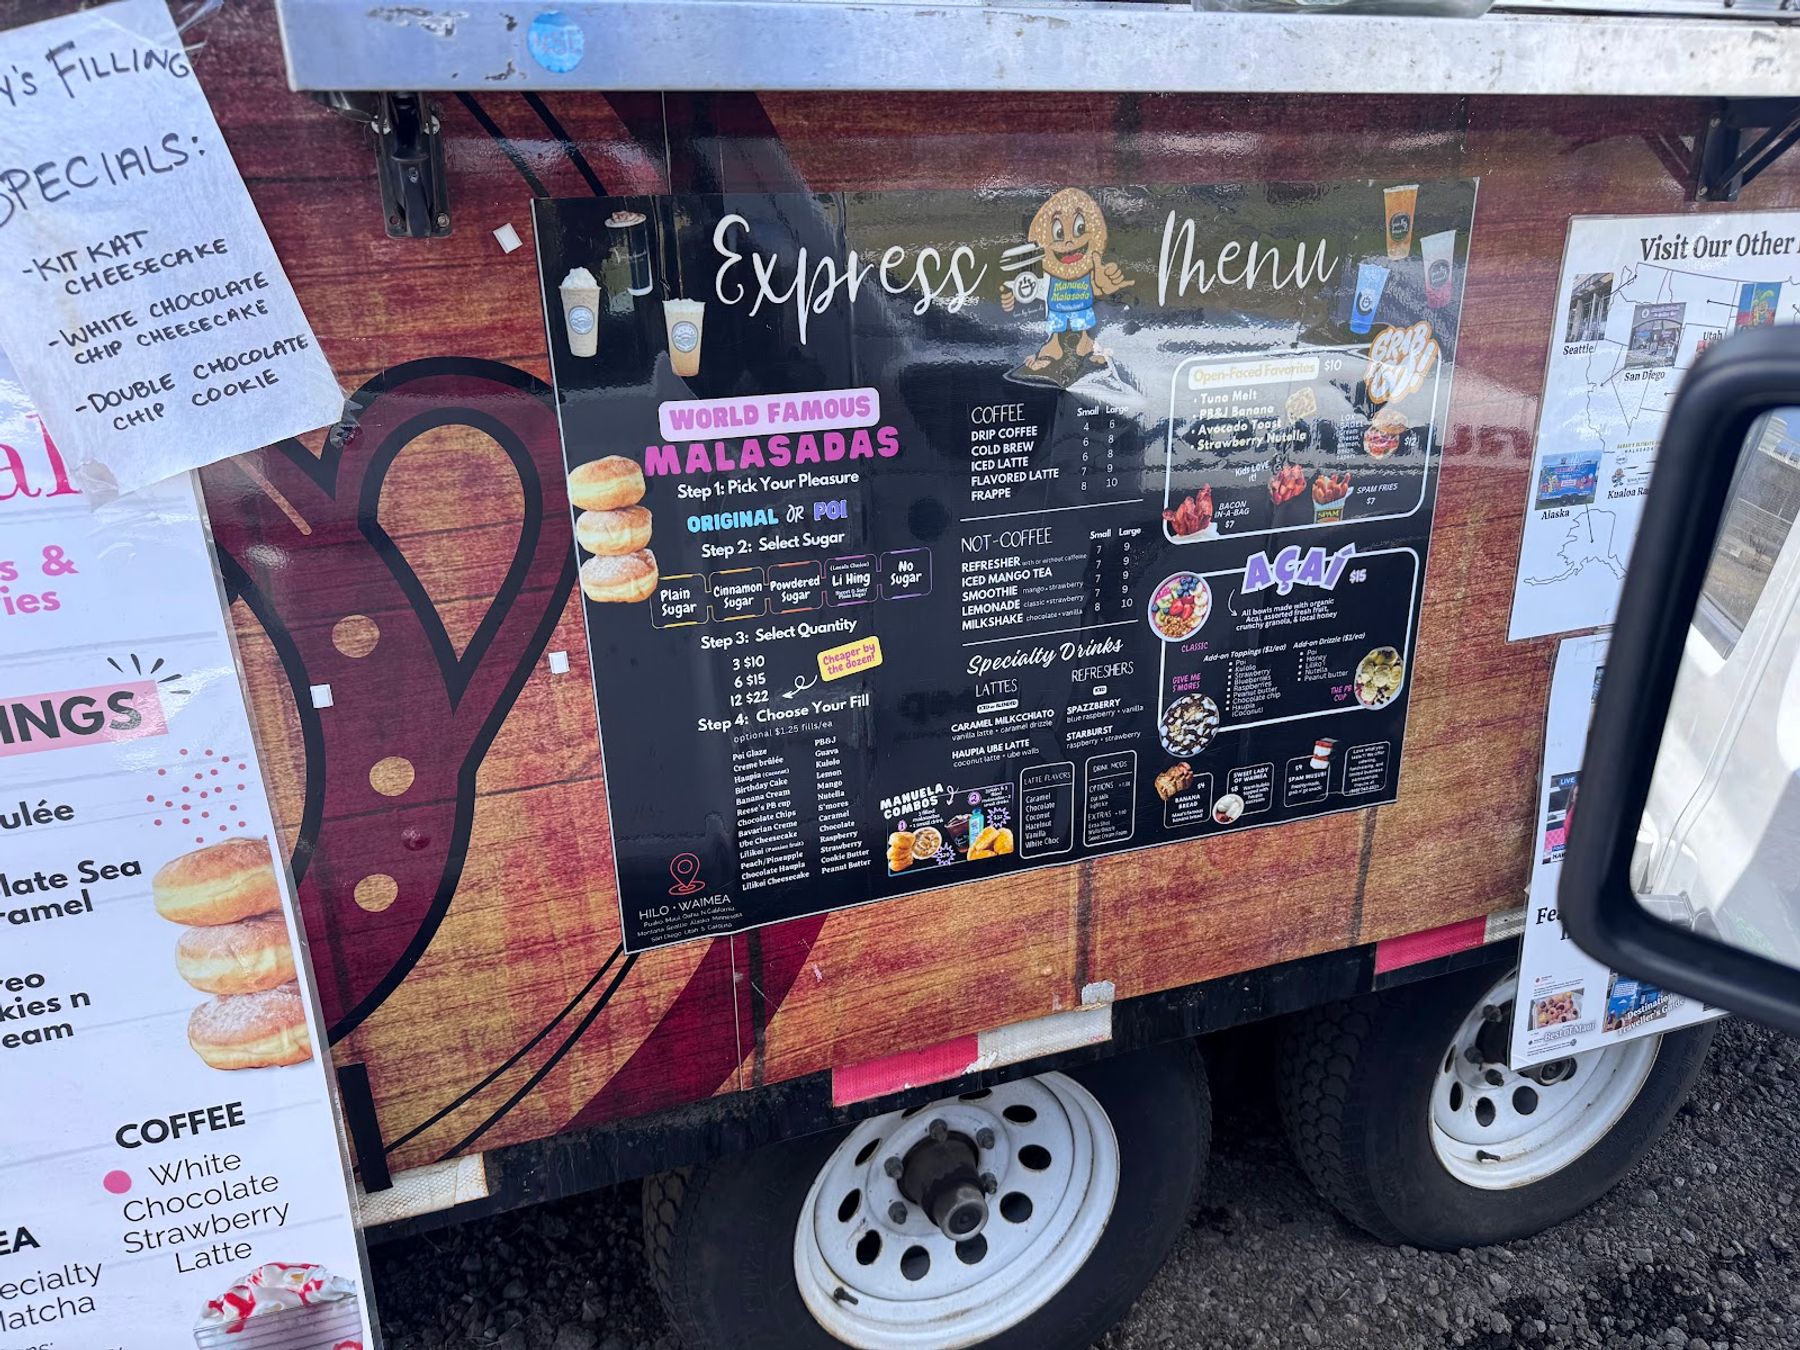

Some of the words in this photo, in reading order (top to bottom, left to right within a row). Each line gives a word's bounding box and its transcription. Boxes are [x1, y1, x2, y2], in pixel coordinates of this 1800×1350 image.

[46, 41, 191, 98] FILLING
[1640, 234, 1689, 261] Visit
[1693, 235, 1732, 259] Our
[1736, 231, 1795, 257] Other
[22, 250, 80, 282] -KIT
[86, 230, 150, 264] KAT
[64, 238, 229, 296] CHEESECAKE
[713, 213, 987, 345] Express
[1158, 209, 1339, 307] Menu
[47, 310, 139, 349] -WHITE
[149, 272, 270, 319] CHOCOLATE
[73, 339, 123, 367] CHIP
[136, 300, 270, 347] CHEESECAKE
[1703, 330, 1723, 341] Utah
[1563, 343, 1594, 356] Seattle
[75, 373, 176, 414] -DOUBLE
[193, 333, 310, 380] CHOCOLATE
[1194, 367, 1262, 382] Open-Faced
[1264, 363, 1315, 377] Favorites
[1324, 360, 1342, 372] $10
[1624, 372, 1641, 381] San
[1642, 370, 1666, 382] Diego
[112, 402, 165, 432] CHIP
[191, 368, 280, 407] COOKIE
[1200, 392, 1229, 403] Tuna
[1232, 390, 1257, 400] Melt
[669, 404, 759, 430] WORLD
[768, 396, 871, 423] FAMOUS
[971, 403, 1025, 424] COFFEE
[1077, 406, 1099, 417] Small
[1106, 405, 1129, 415] Large
[1200, 407, 1229, 420] PB&J
[1230, 405, 1274, 415] Banana
[971, 430, 995, 442] DRIP
[998, 426, 1038, 439] COFFEE
[1198, 423, 1249, 435] Avocado
[1251, 419, 1281, 430] Toast
[971, 445, 1001, 457] COLD
[1003, 441, 1035, 454] BREW
[1197, 436, 1263, 452] Strawberry
[1267, 430, 1306, 442] Nutella
[644, 426, 900, 476] MALASADAS
[971, 460, 996, 472] ICED
[997, 456, 1029, 469] LATTE
[971, 472, 1027, 487] FLAVORED
[1029, 468, 1059, 481] LATTE
[677, 483, 712, 502] Step
[714, 482, 725, 496] 1:
[728, 479, 757, 495] Pick
[759, 475, 796, 492] Your
[799, 471, 860, 488] Pleasure
[971, 487, 1012, 501] FRAPPE
[1357, 485, 1377, 494] SPAM
[1379, 483, 1398, 491] FRIES
[1607, 488, 1636, 500] Kualoa
[1214, 508, 1250, 519] IN-A-BAG
[1218, 500, 1247, 511] BACON
[687, 508, 779, 534] ORIGINAL
[786, 505, 804, 523] OR
[813, 500, 848, 521] POI
[1541, 509, 1570, 521] Alaska
[701, 544, 734, 559] Step
[737, 540, 752, 554] 2:
[758, 534, 801, 552] Select
[803, 532, 845, 548] Sugar
[961, 527, 1053, 553] NOT-COFFEE
[1089, 528, 1111, 540] Small
[1118, 527, 1142, 537] Large
[42, 545, 80, 576] &
[898, 561, 914, 572] No
[961, 557, 1021, 573] REFRESHER
[770, 575, 820, 592] Powdered
[832, 573, 842, 587] Li
[846, 573, 871, 587] Hing
[890, 571, 922, 586] Sugar
[961, 576, 986, 588] ICED
[988, 570, 1030, 584] MANGO
[1033, 567, 1053, 578] TEA
[1349, 569, 1367, 583] $15
[660, 588, 690, 602] Plain
[713, 582, 762, 598] Cinnamon
[781, 590, 810, 603] Sugar
[961, 586, 1018, 602] SMOOTHIE
[662, 602, 697, 617] Sugar
[723, 595, 754, 608] Sugar
[961, 599, 1021, 617] LEMONADE
[961, 613, 1024, 631] MILKSHAKE
[701, 635, 733, 650] Step
[735, 632, 749, 645] 3:
[755, 627, 795, 643] Select
[797, 617, 857, 638] Quantity
[822, 647, 861, 665] Cheaper
[863, 642, 875, 654] by
[1181, 641, 1209, 653] CLASSIC
[732, 659, 741, 670] 3
[744, 656, 765, 669] $10
[827, 665, 845, 675] the
[846, 653, 876, 669] dozen!
[966, 647, 1056, 677] Specialty
[1060, 636, 1123, 661] Drinks
[1071, 661, 1134, 683] REFRESHERS
[734, 677, 742, 688] 6
[746, 674, 766, 687] $15
[975, 678, 1018, 698] LATTES
[730, 695, 742, 707] 12
[746, 691, 769, 705] $22
[1066, 698, 1121, 715] SPAZZBERRY
[698, 718, 731, 733] Step
[733, 714, 749, 727] 4:
[756, 706, 809, 723] Choose
[812, 700, 847, 715] Your
[849, 694, 870, 708] Fill
[951, 720, 993, 733] CARAMEL
[994, 709, 1055, 726] MILKCCHIATO
[734, 731, 772, 744] optional
[775, 726, 799, 736] $1.25
[801, 721, 833, 731] fills/ea
[1065, 725, 1113, 741] STARBURST
[815, 748, 839, 757] Guava
[952, 747, 985, 760] HAUPIA
[986, 743, 1004, 753] UBE
[1004, 738, 1030, 750] LATTE
[816, 769, 842, 779] Lemon
[1560, 777, 1575, 786] LIVE
[735, 783, 768, 795] Birthday
[769, 778, 788, 787] Cake
[817, 780, 843, 791] Mango
[736, 796, 764, 806] Banana
[765, 789, 791, 799] Cream
[880, 783, 944, 811] MANUELA
[818, 810, 850, 822] Caramel
[884, 795, 939, 820] COMBOS
[819, 820, 855, 833] Chocolate
[820, 840, 863, 854] Strawberry
[77, 859, 142, 883] Sea
[821, 864, 847, 874] Peanut
[848, 858, 872, 869] Butter
[639, 906, 669, 920] HILO
[678, 894, 731, 912] WAIMEA
[70, 992, 91, 1008] n
[1627, 994, 1673, 1018] Destination
[1618, 1011, 1661, 1035] Traveller's
[1544, 1030, 1564, 1041] Best
[115, 1102, 246, 1149] COFFEE
[147, 1152, 242, 1187] White
[122, 1174, 279, 1222] Chocolate
[122, 1202, 290, 1255] Strawberry
[174, 1240, 253, 1275] Latte
